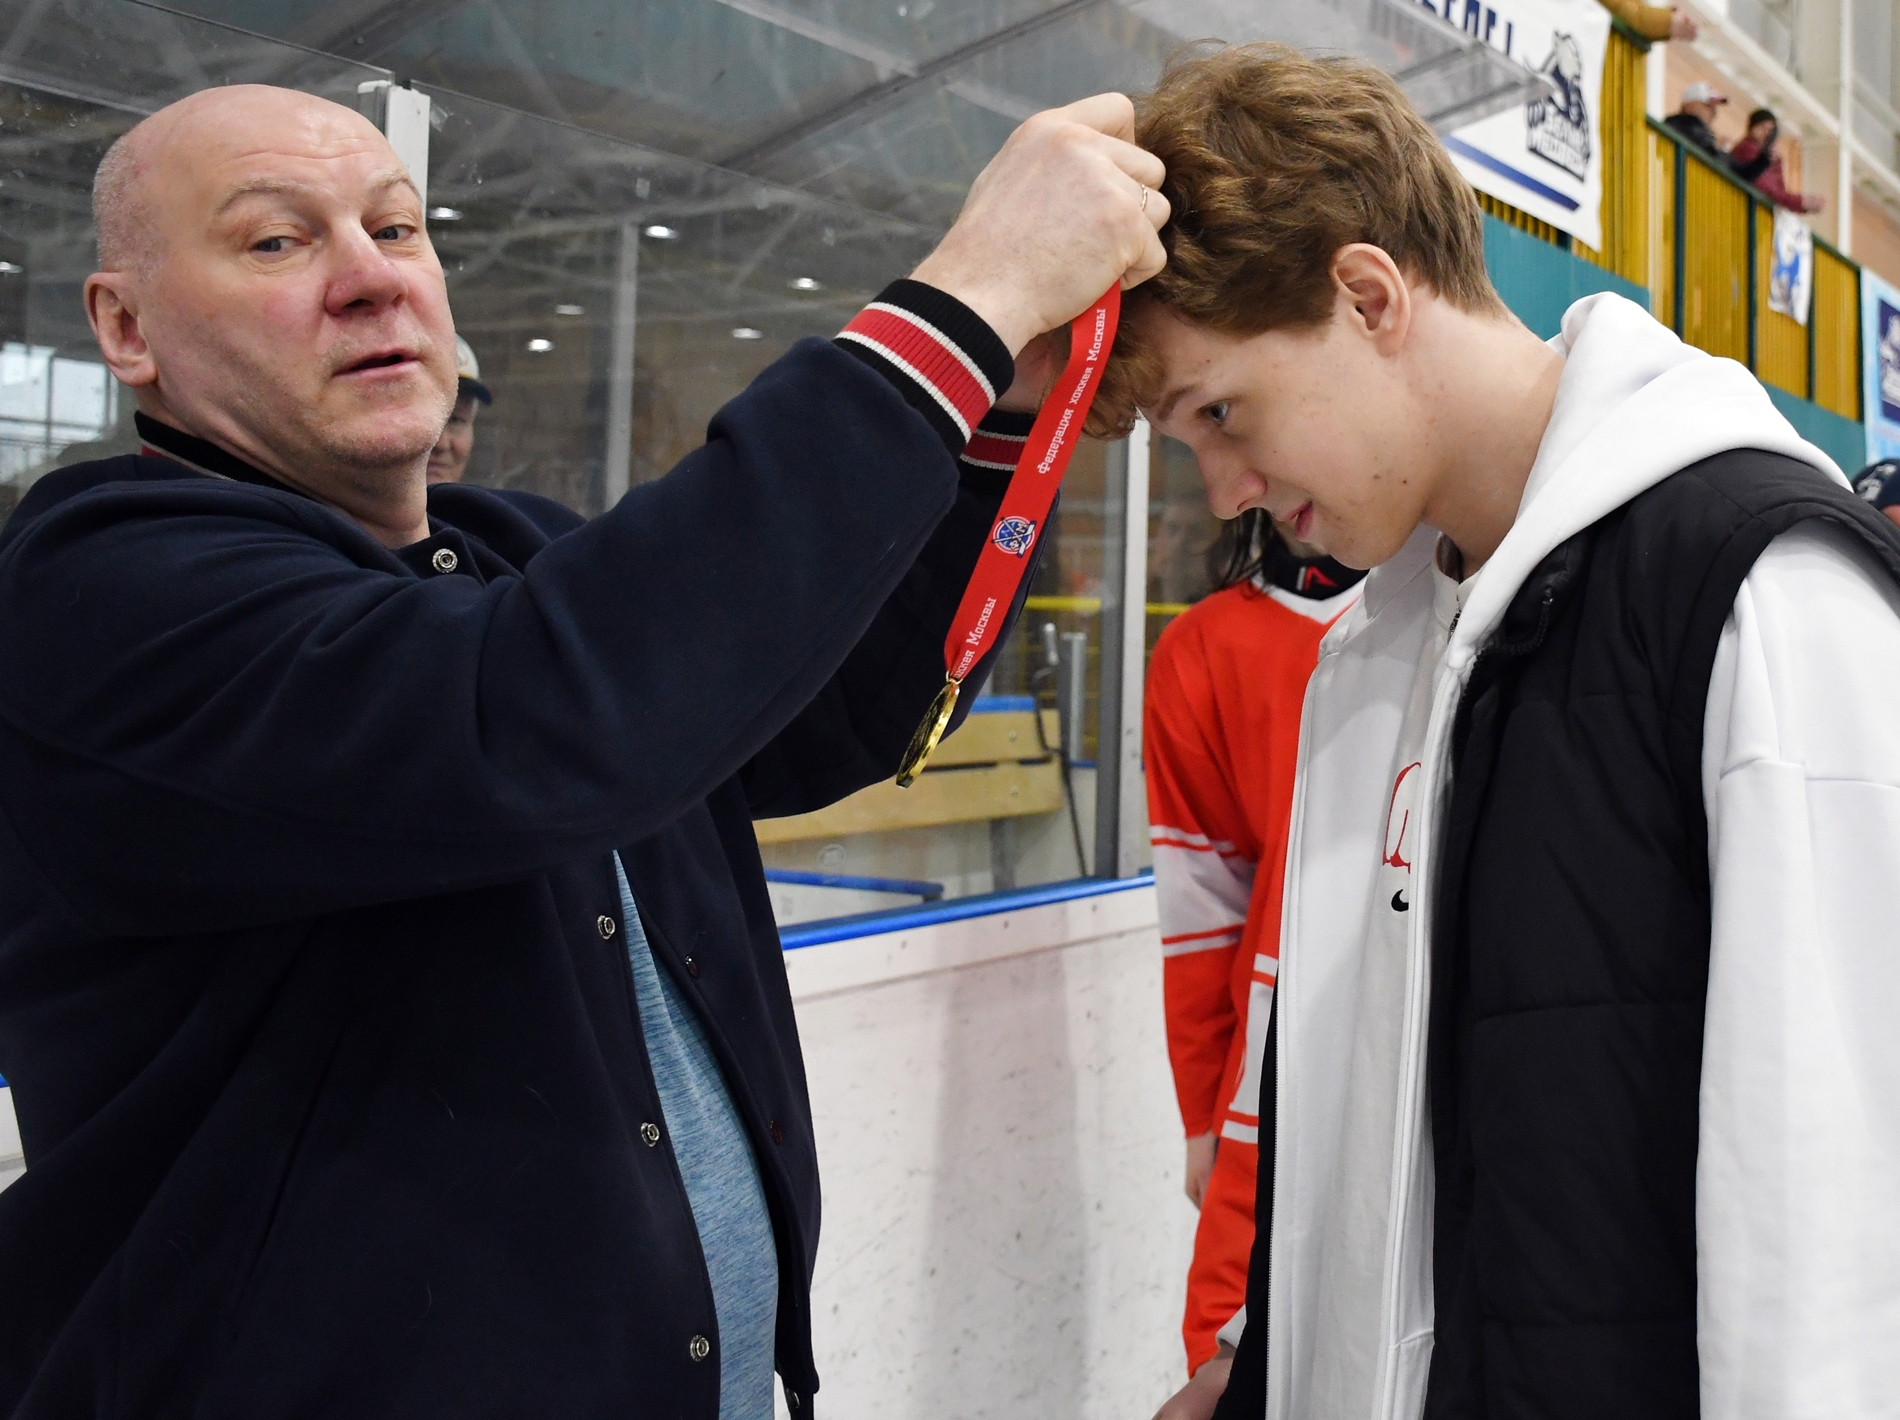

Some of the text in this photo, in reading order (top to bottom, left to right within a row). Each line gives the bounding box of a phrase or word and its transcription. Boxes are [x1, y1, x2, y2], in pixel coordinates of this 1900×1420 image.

[1037, 308, 1106, 474] Федерация хоккея Москвы
[966, 597, 997, 646] Москвы
